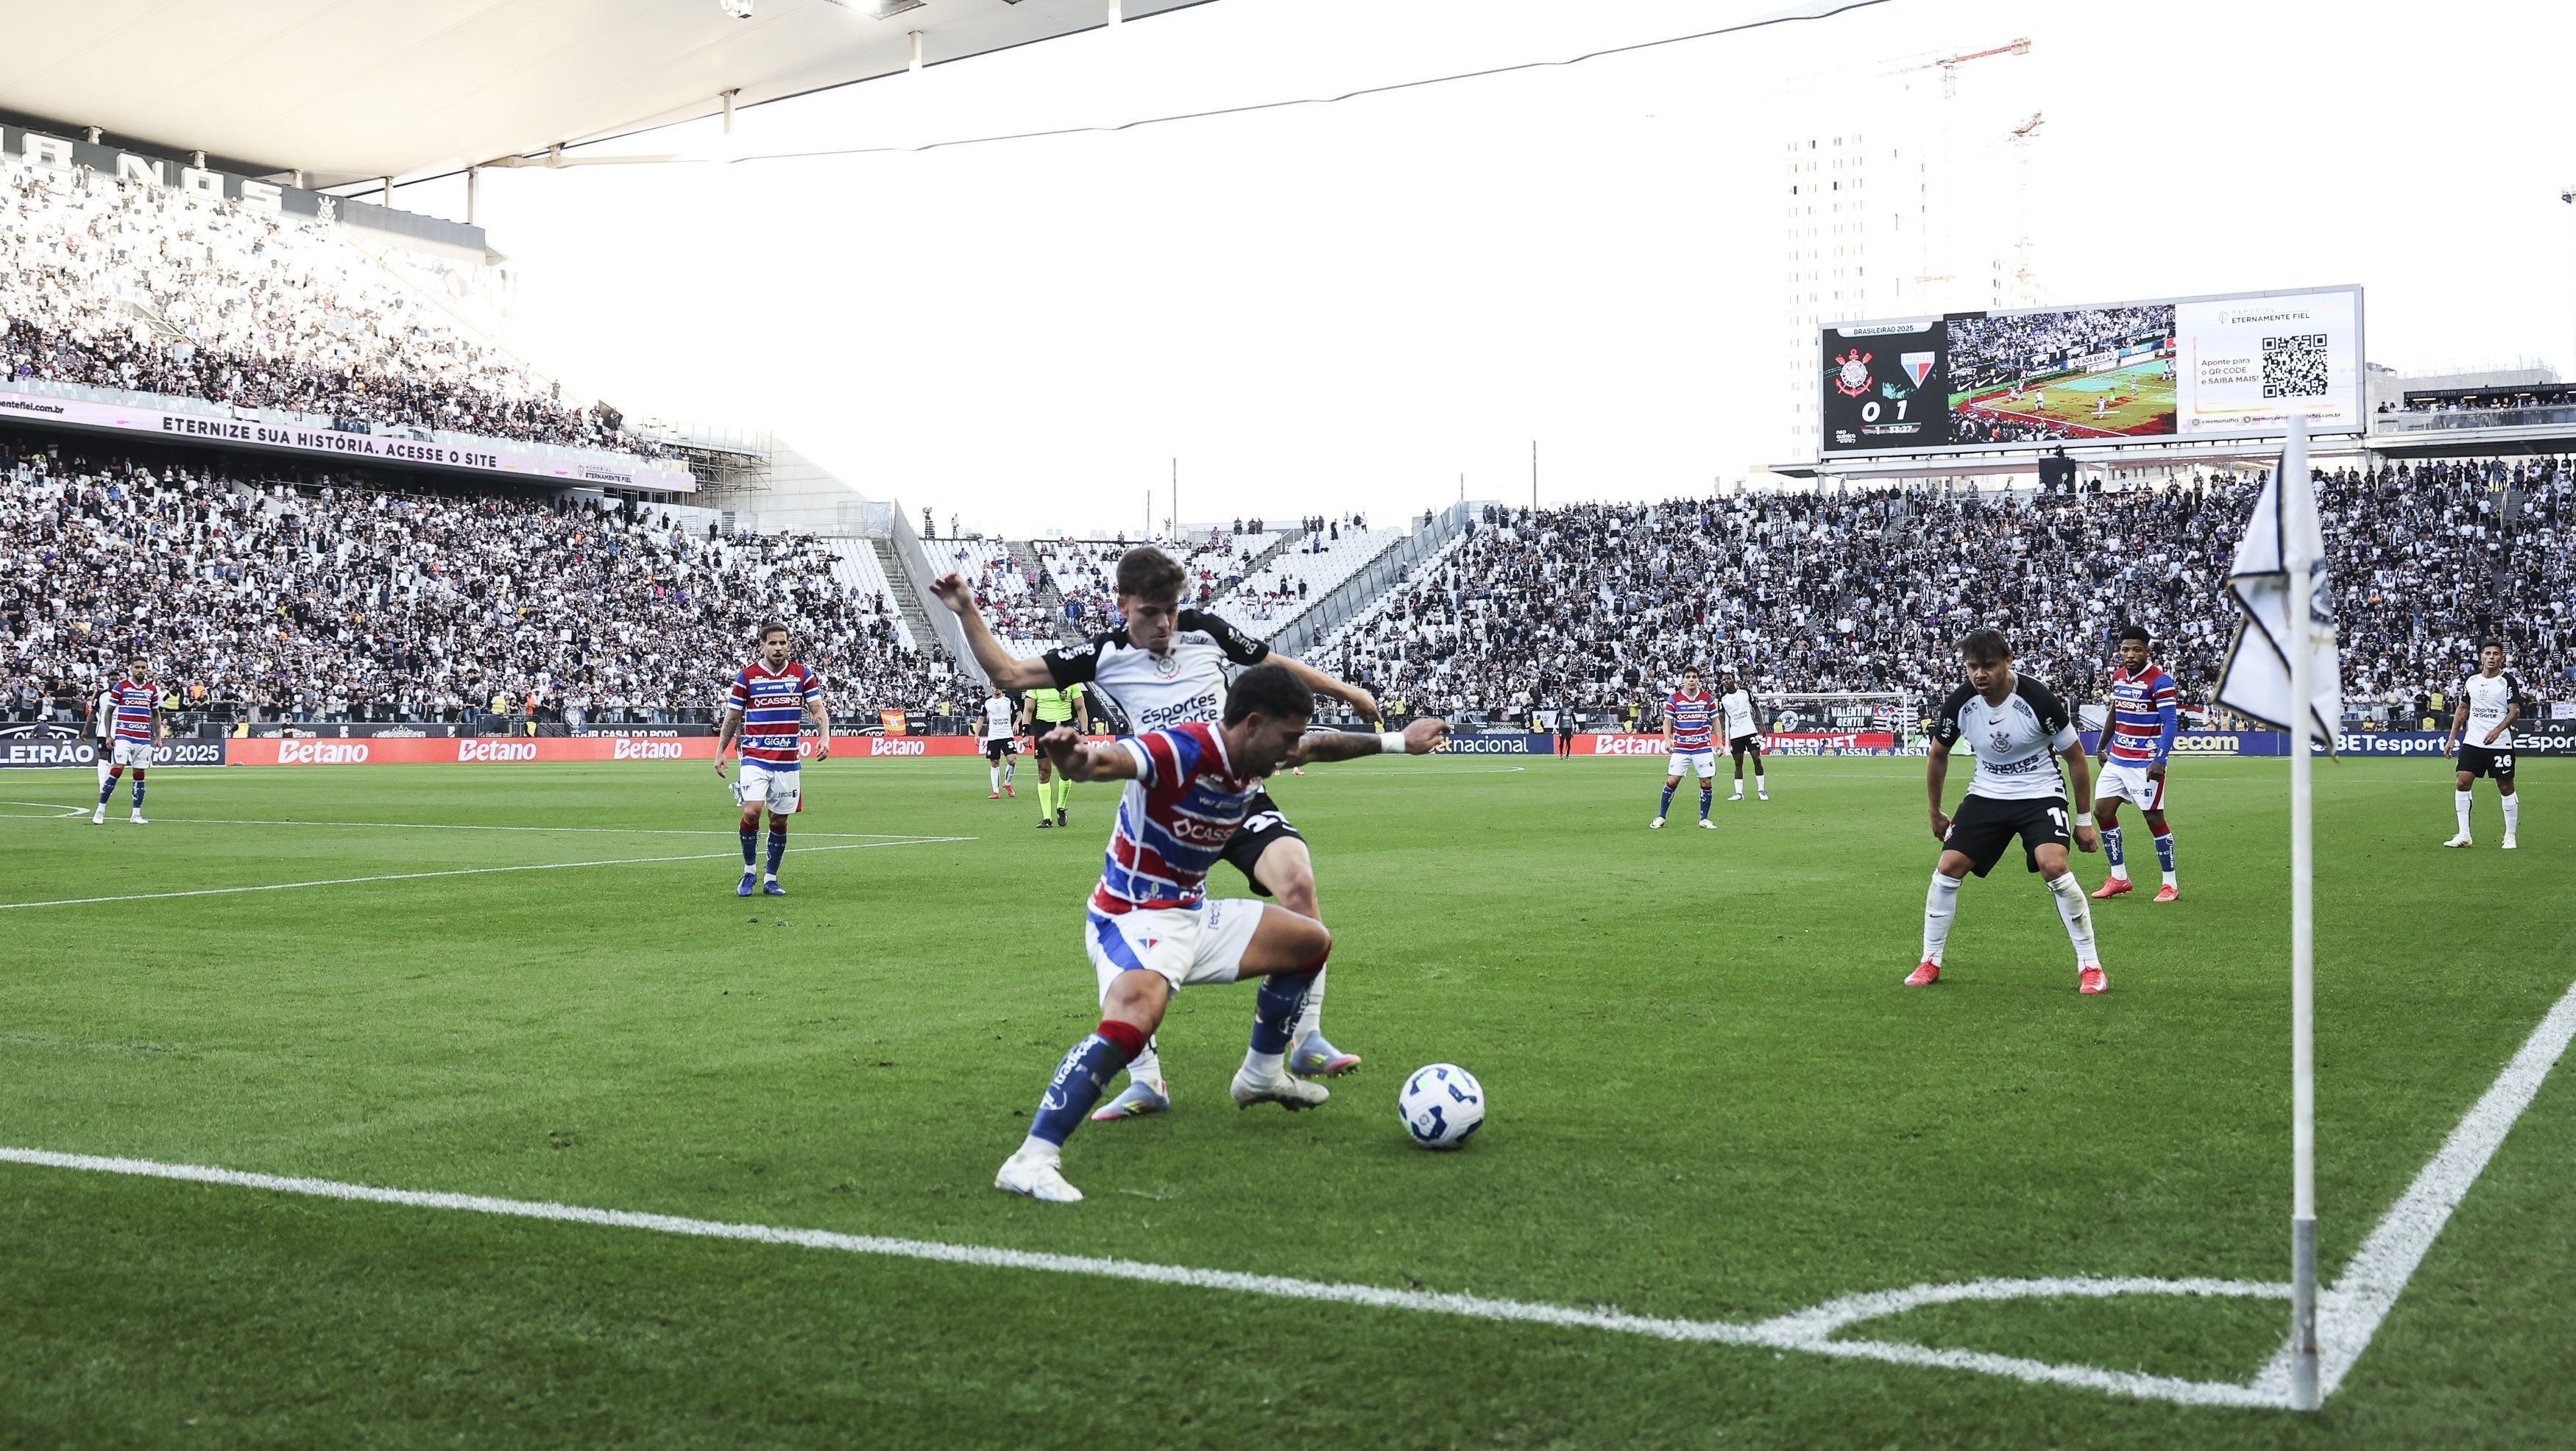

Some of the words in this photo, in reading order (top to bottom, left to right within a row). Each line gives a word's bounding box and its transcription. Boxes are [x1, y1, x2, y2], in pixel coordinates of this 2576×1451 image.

[2232, 314, 2290, 324] ETERNAMENTE
[2233, 358, 2250, 366] para
[1861, 401, 1880, 422] 0
[1897, 400, 1908, 420] 1
[163, 416, 250, 439] ETERNIZE
[258, 428, 290, 444] SUA
[297, 433, 380, 454] HISTÓRIA.
[386, 444, 443, 462] ACESSE
[450, 450, 459, 463] O
[465, 453, 497, 467] SITE
[585, 472, 621, 482] ETERNAMENTE
[1065, 642, 1096, 659] bmg
[1234, 630, 1259, 655] bmg
[760, 697, 800, 705] CASSINO
[1141, 692, 1217, 725] Esportes
[1830, 706, 1873, 717] VALENTIM
[1836, 717, 1865, 727] GENTIL
[601, 730, 630, 738] CASA
[650, 730, 678, 738] POVO
[277, 739, 369, 764] Betano
[457, 739, 537, 762] Betano
[613, 739, 683, 760] Betano
[871, 737, 925, 756] Betano
[1432, 736, 1529, 753] etnacional
[2171, 736, 2240, 751] ecom
[2513, 733, 2576, 753] Espor
[174, 745, 220, 762] 2025
[2494, 754, 2512, 768] 26
[2046, 806, 2071, 834] 11
